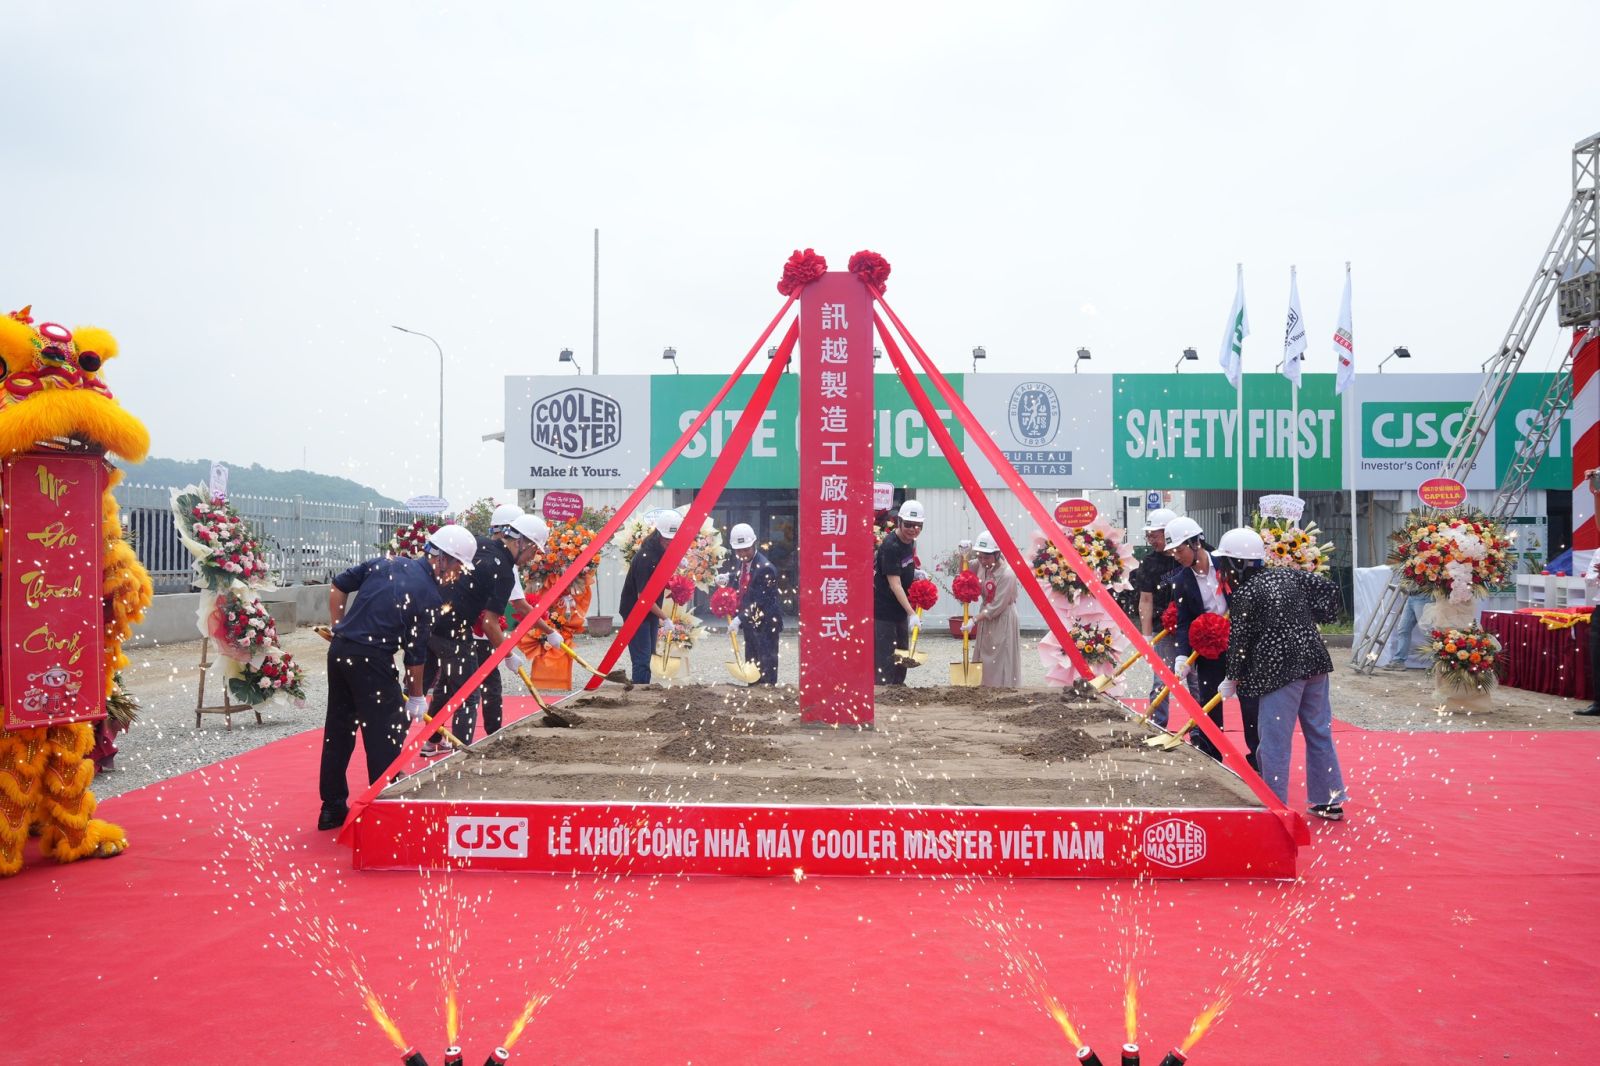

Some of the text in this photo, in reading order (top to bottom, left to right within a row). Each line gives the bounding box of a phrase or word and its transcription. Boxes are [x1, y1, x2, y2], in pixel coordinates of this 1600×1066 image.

[536, 393, 616, 423] COOLER
[536, 424, 616, 453] MASTER
[1126, 408, 1336, 459] SAFETY FIRST
[1372, 412, 1464, 448] CJSC
[530, 465, 621, 477] Make it Yours.
[820, 302, 849, 639] 訊越製造工廠動土儀式
[1013, 464, 1067, 474] ERITAS
[1361, 460, 1413, 471] Investor's
[455, 823, 519, 850] CJSC
[548, 815, 572, 856] LỄ
[579, 817, 630, 856] KHỞI
[637, 821, 697, 858] CÔNG
[704, 822, 750, 858] NHÀ
[757, 822, 806, 859] MÁY
[812, 828, 896, 859] COOLER
[903, 829, 993, 860] MASTER
[999, 823, 1046, 866] VIỆT
[1147, 822, 1203, 843] COOLER
[1147, 843, 1203, 864] MASTER
